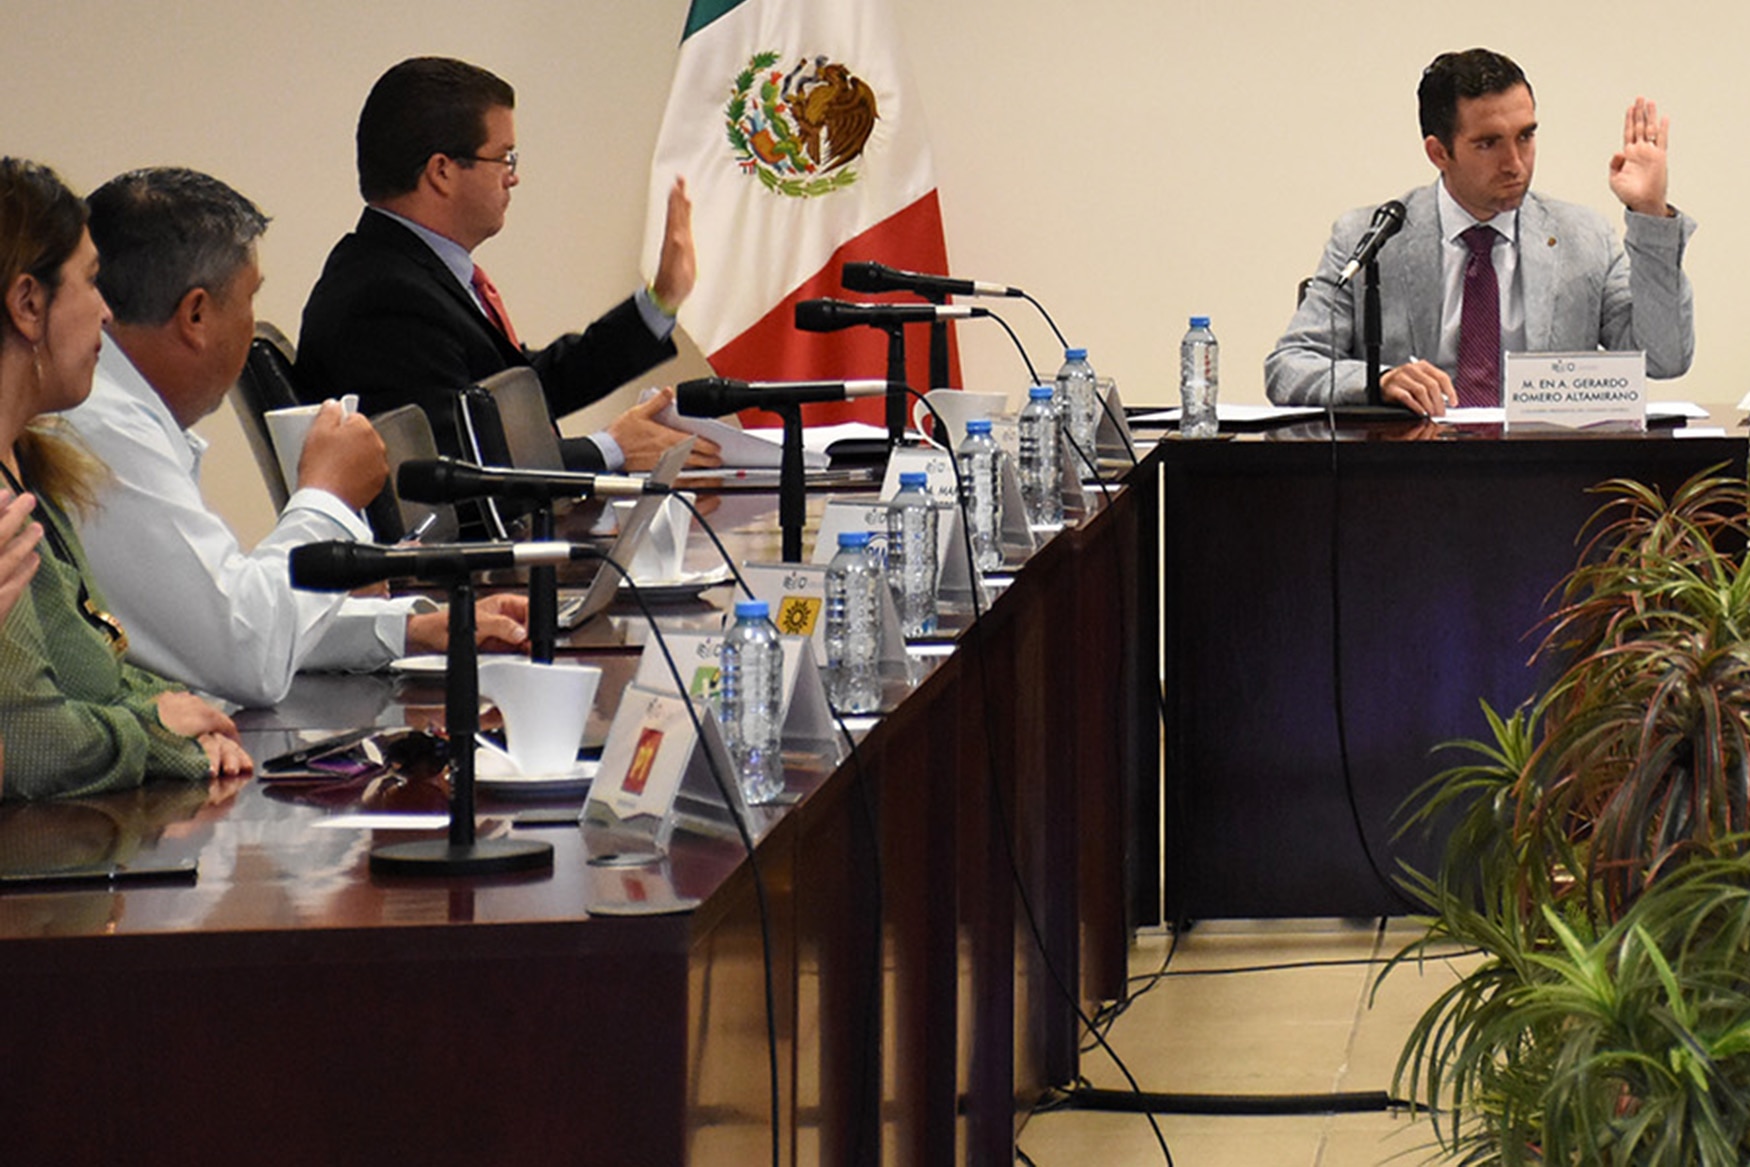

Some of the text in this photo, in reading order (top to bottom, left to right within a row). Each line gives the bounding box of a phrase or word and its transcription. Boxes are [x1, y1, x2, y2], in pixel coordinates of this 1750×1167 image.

[1540, 379, 1555, 389] EN
[1573, 377, 1629, 389] GERARDO
[1512, 390, 1639, 403] ROMERO ALTAMIRANO
